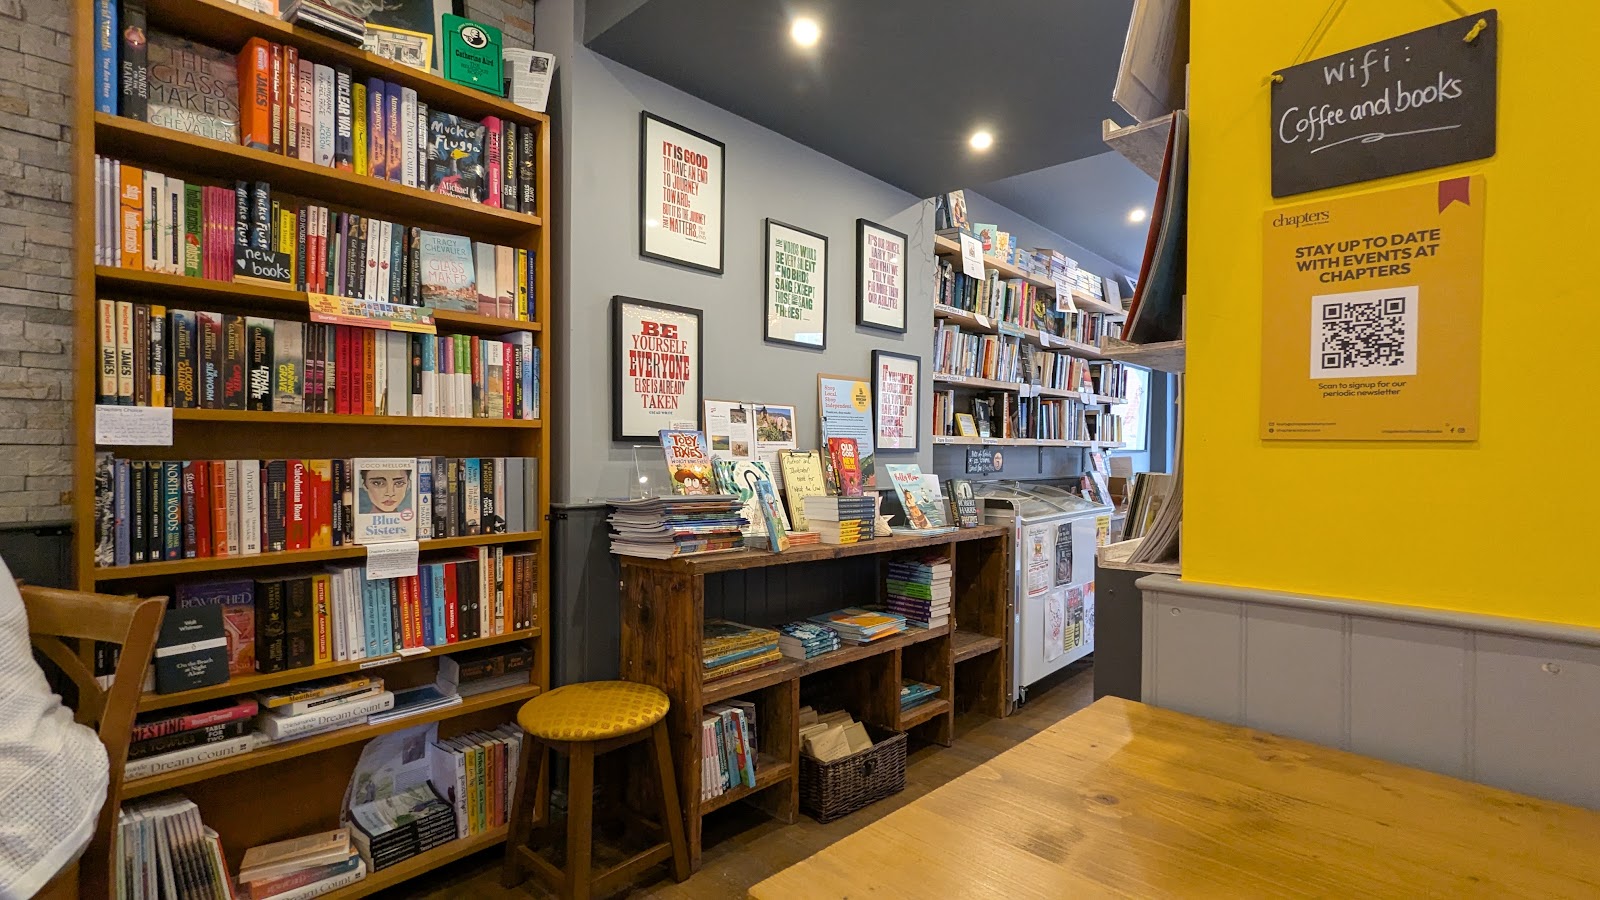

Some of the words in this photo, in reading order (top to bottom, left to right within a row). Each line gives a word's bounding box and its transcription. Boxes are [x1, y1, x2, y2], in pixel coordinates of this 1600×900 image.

[171, 49, 213, 76] THE
[123, 61, 133, 95] REAPING
[138, 65, 147, 99] SUNRISE
[151, 64, 226, 98] GLASS
[255, 72, 268, 107] JAMES
[337, 72, 350, 115] NUCLEAR
[149, 83, 231, 120] MAKER
[1279, 104, 1347, 144] Coffee
[1350, 87, 1391, 121] and
[1394, 71, 1463, 112] books
[168, 105, 217, 126] TRACY
[337, 115, 350, 138] WAR
[150, 114, 233, 143] CHEVALIER
[407, 120, 416, 149] Dream
[430, 120, 476, 139] Muckle
[435, 134, 482, 153] Flugga
[407, 150, 416, 177] Count
[662, 140, 673, 157] IT
[673, 145, 683, 161] IS
[684, 149, 708, 170] GOOD
[662, 156, 671, 173] TO
[672, 159, 687, 178] HAVE
[688, 165, 696, 181] AN
[697, 169, 708, 185] END
[441, 181, 469, 195] Michael
[662, 172, 671, 188] TO
[672, 176, 699, 197] JOURNEY
[237, 188, 248, 221] Muckle
[256, 188, 268, 221] Muckle
[662, 203, 671, 216] BUT
[671, 205, 676, 217] IT
[676, 206, 681, 219] IS
[689, 210, 706, 226] JOURNEY
[1272, 210, 1330, 228] chapters
[424, 243, 467, 256] CHEVALIER
[431, 236, 458, 248] TRACY
[1295, 242, 1336, 259] STAY
[1337, 239, 1361, 253] UP
[1362, 236, 1388, 250] TO
[1391, 228, 1441, 246] DATE
[186, 242, 200, 270] lobster
[245, 249, 276, 263] new
[429, 258, 466, 275] GLASS
[775, 251, 784, 265] BE
[784, 253, 797, 268] VERY
[1296, 256, 1340, 272] WITH
[1343, 247, 1412, 267] EVENTS
[1414, 244, 1440, 259] AT
[251, 261, 291, 280] books
[428, 270, 468, 286] MAKER
[781, 265, 791, 279] NO
[791, 268, 809, 284] BIRDS
[1319, 262, 1411, 284] CHAPTERS
[775, 277, 793, 293] SANG
[775, 303, 788, 317] THE
[788, 305, 803, 320] BEST
[178, 320, 186, 358] GALBRAITH
[641, 320, 678, 339] BE
[228, 323, 236, 360] GALBRAITH
[632, 334, 687, 354] YOURSELF
[103, 348, 115, 375] JAMES
[121, 350, 132, 376] JAMES
[629, 349, 690, 380] EVERYONE
[177, 361, 186, 392] CALLING
[184, 366, 193, 401] CUCKOO'S
[206, 362, 214, 401] SILKWORM
[251, 369, 262, 400] WHITE
[260, 365, 270, 396] LETHAL
[279, 364, 288, 392] GRAVE
[634, 378, 651, 393] ELSE
[651, 380, 658, 394] IS
[659, 380, 686, 395] ALREADY
[1318, 382, 1338, 390] Scan
[1348, 381, 1376, 391] signup
[1377, 380, 1391, 388] for
[641, 394, 678, 409] TAKEN
[1322, 389, 1356, 399] periodic
[1356, 388, 1401, 396] newsletter
[669, 434, 698, 447] TOBY
[841, 443, 854, 452] OLD
[844, 457, 855, 465] NEW
[167, 464, 179, 495] NORTH
[293, 463, 304, 503] Caledonian
[167, 497, 180, 531] WOODS
[293, 503, 303, 521] Road
[372, 514, 400, 526] Blue
[366, 524, 407, 536] Sisters
[178, 624, 204, 632] Whitman
[187, 661, 196, 669] the
[196, 658, 214, 666] Beach
[187, 670, 205, 678] Alone
[192, 665, 207, 673] Night
[318, 710, 352, 725] Dream
[353, 703, 381, 716] Count
[205, 723, 226, 733] TABLE
[208, 730, 224, 738] FOR
[206, 735, 225, 744] TWO
[150, 755, 195, 774] Dream
[197, 746, 235, 762] Count
[320, 876, 351, 892] Count
